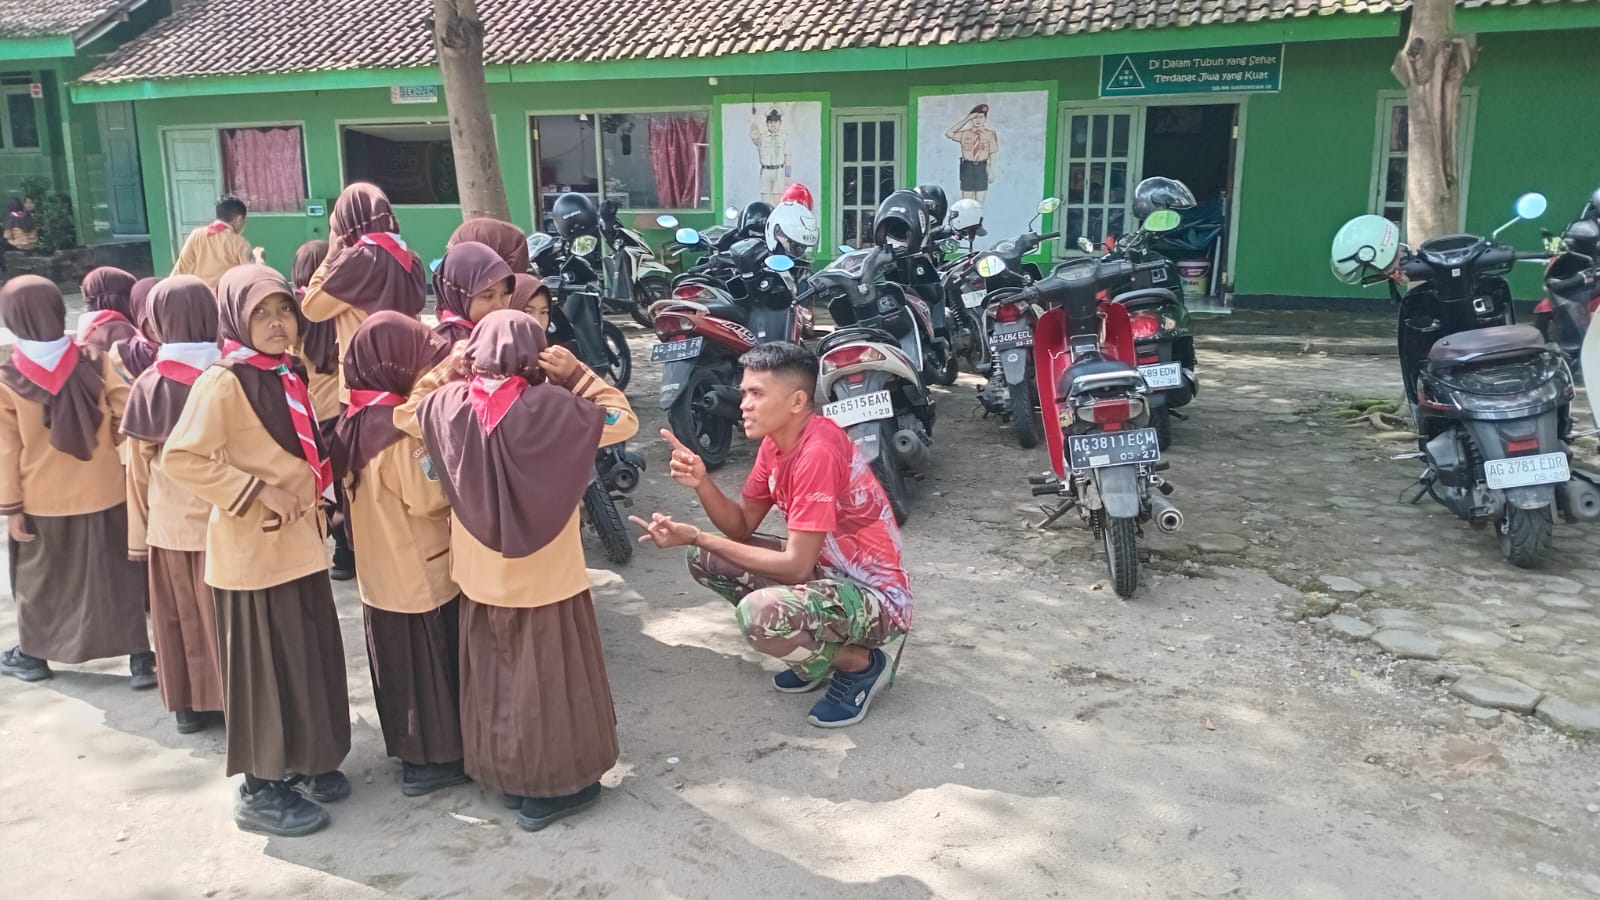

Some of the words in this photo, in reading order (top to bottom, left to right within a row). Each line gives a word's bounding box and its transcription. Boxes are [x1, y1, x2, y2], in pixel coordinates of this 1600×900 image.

[1162, 59, 1191, 69] Dalam
[1193, 58, 1224, 68] Tubuh
[1226, 57, 1247, 66] yang
[1249, 55, 1277, 66] Sehat
[1153, 73, 1197, 84] Terdapat
[1198, 72, 1220, 82] Jiwa
[1222, 71, 1243, 81] yang
[1244, 70, 1270, 81] Kuat
[400, 87, 434, 96] SEKOLAH
[1490, 463, 1504, 476] AG
[1507, 460, 1536, 475] 3781
